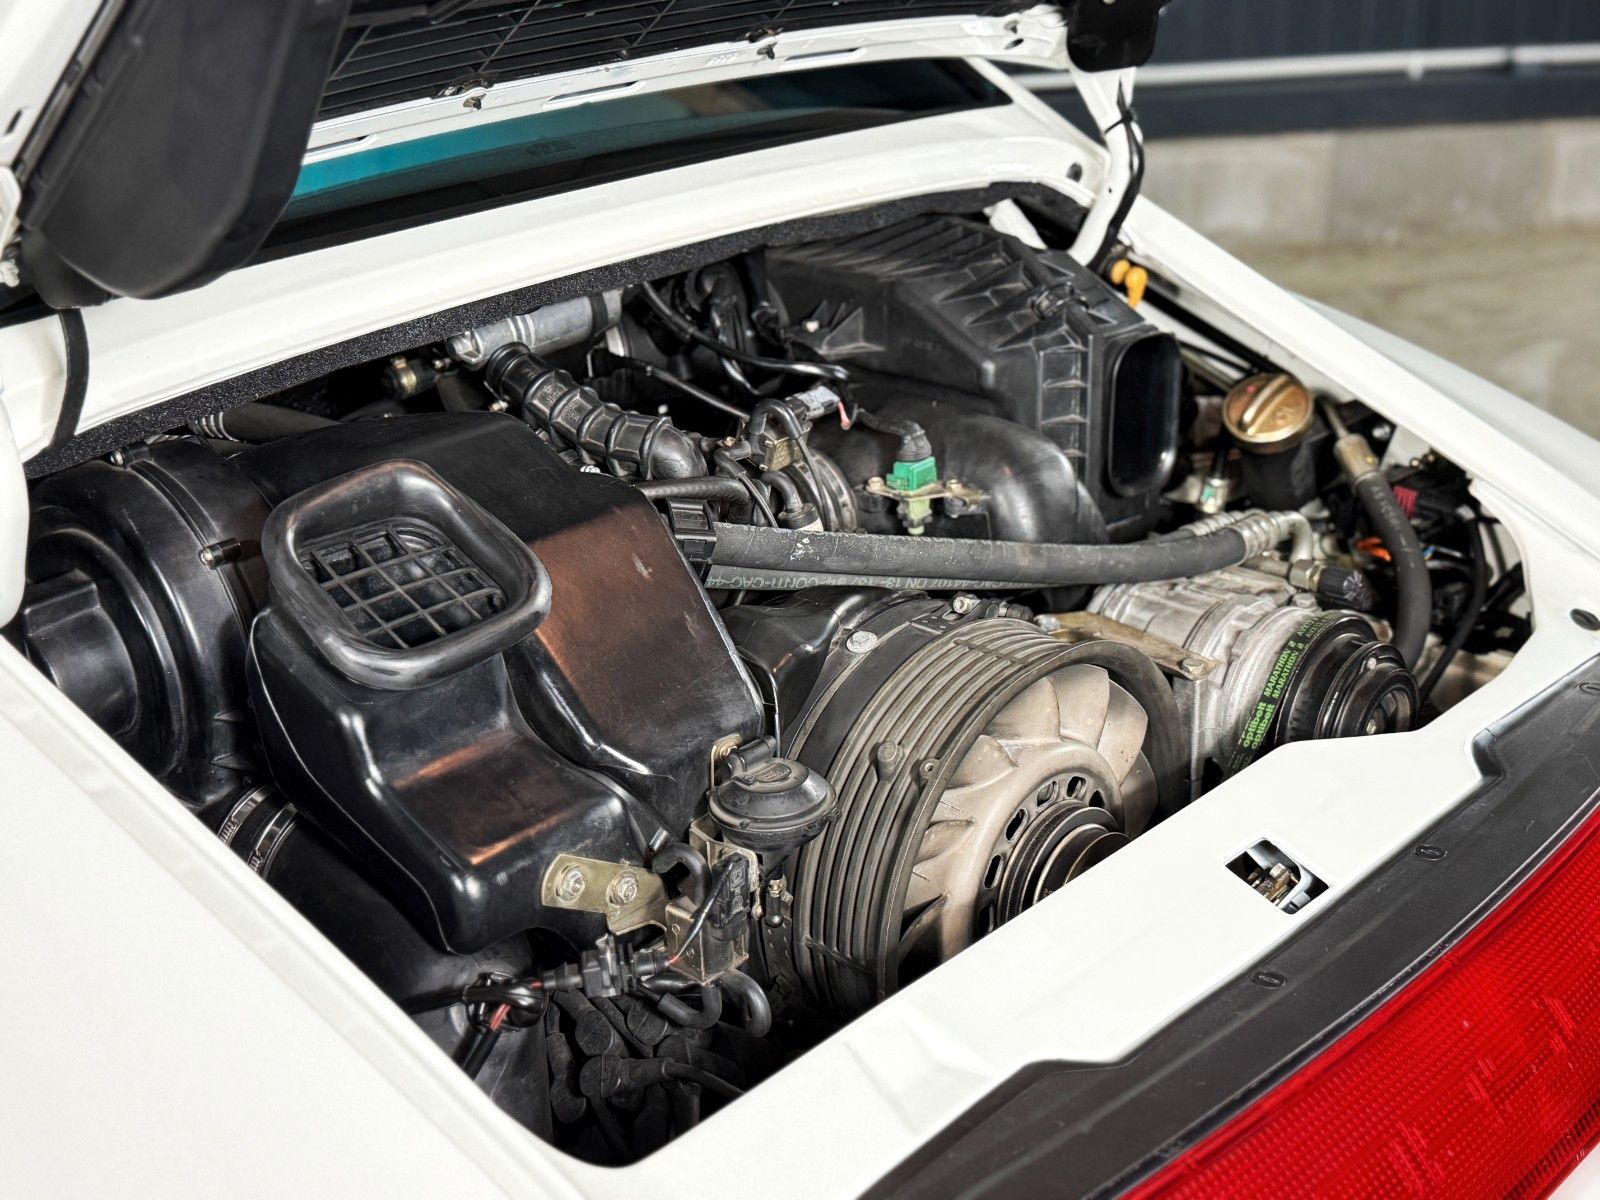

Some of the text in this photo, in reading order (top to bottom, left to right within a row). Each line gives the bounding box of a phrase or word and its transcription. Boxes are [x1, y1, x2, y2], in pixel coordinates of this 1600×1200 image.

[1243, 702, 1266, 747] optibelt
[1264, 648, 1291, 697] MARATHON
[1251, 704, 1275, 749] optibelt
[1272, 650, 1299, 699] MARATHON
